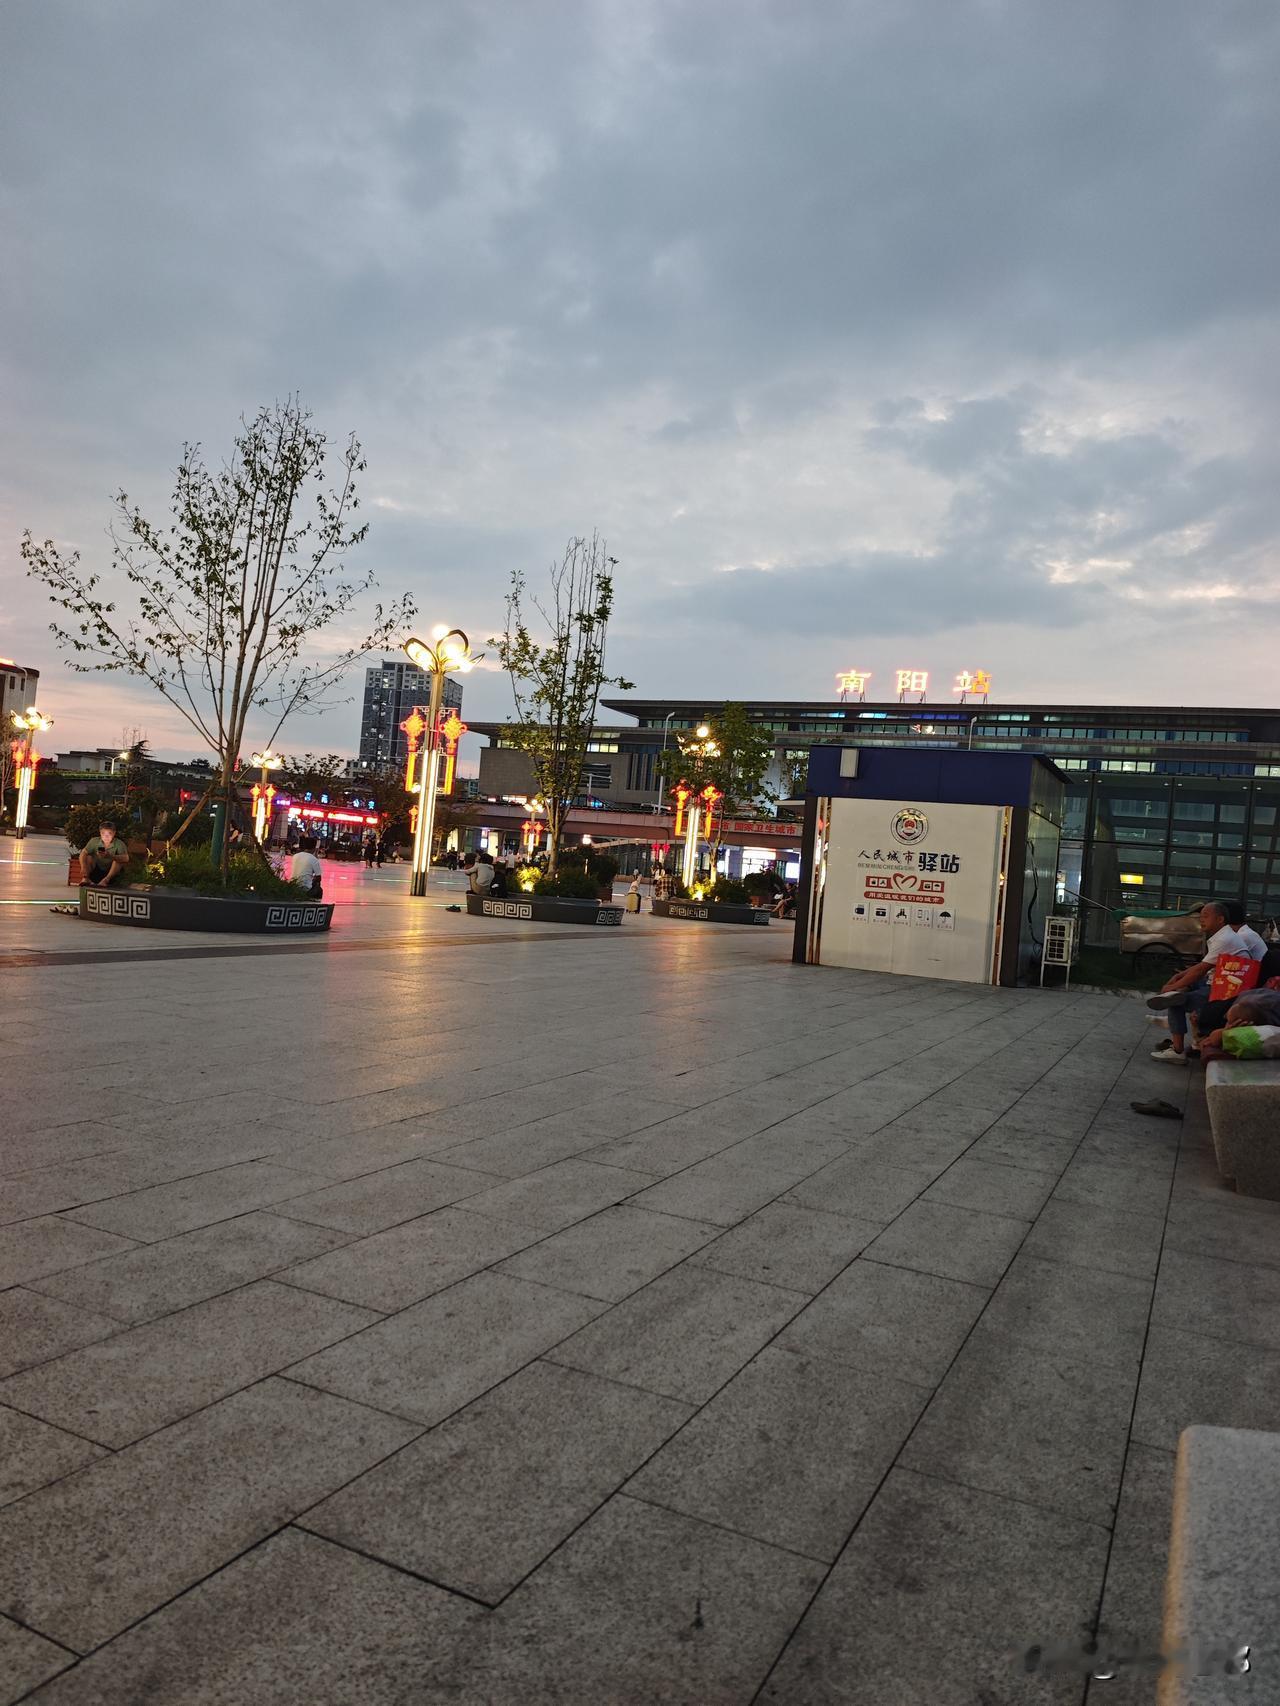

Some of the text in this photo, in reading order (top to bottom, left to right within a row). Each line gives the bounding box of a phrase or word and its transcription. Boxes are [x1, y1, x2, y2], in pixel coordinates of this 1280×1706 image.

[835, 669, 992, 694] 南阳站
[857, 849, 960, 873] 人民城市 驿站
